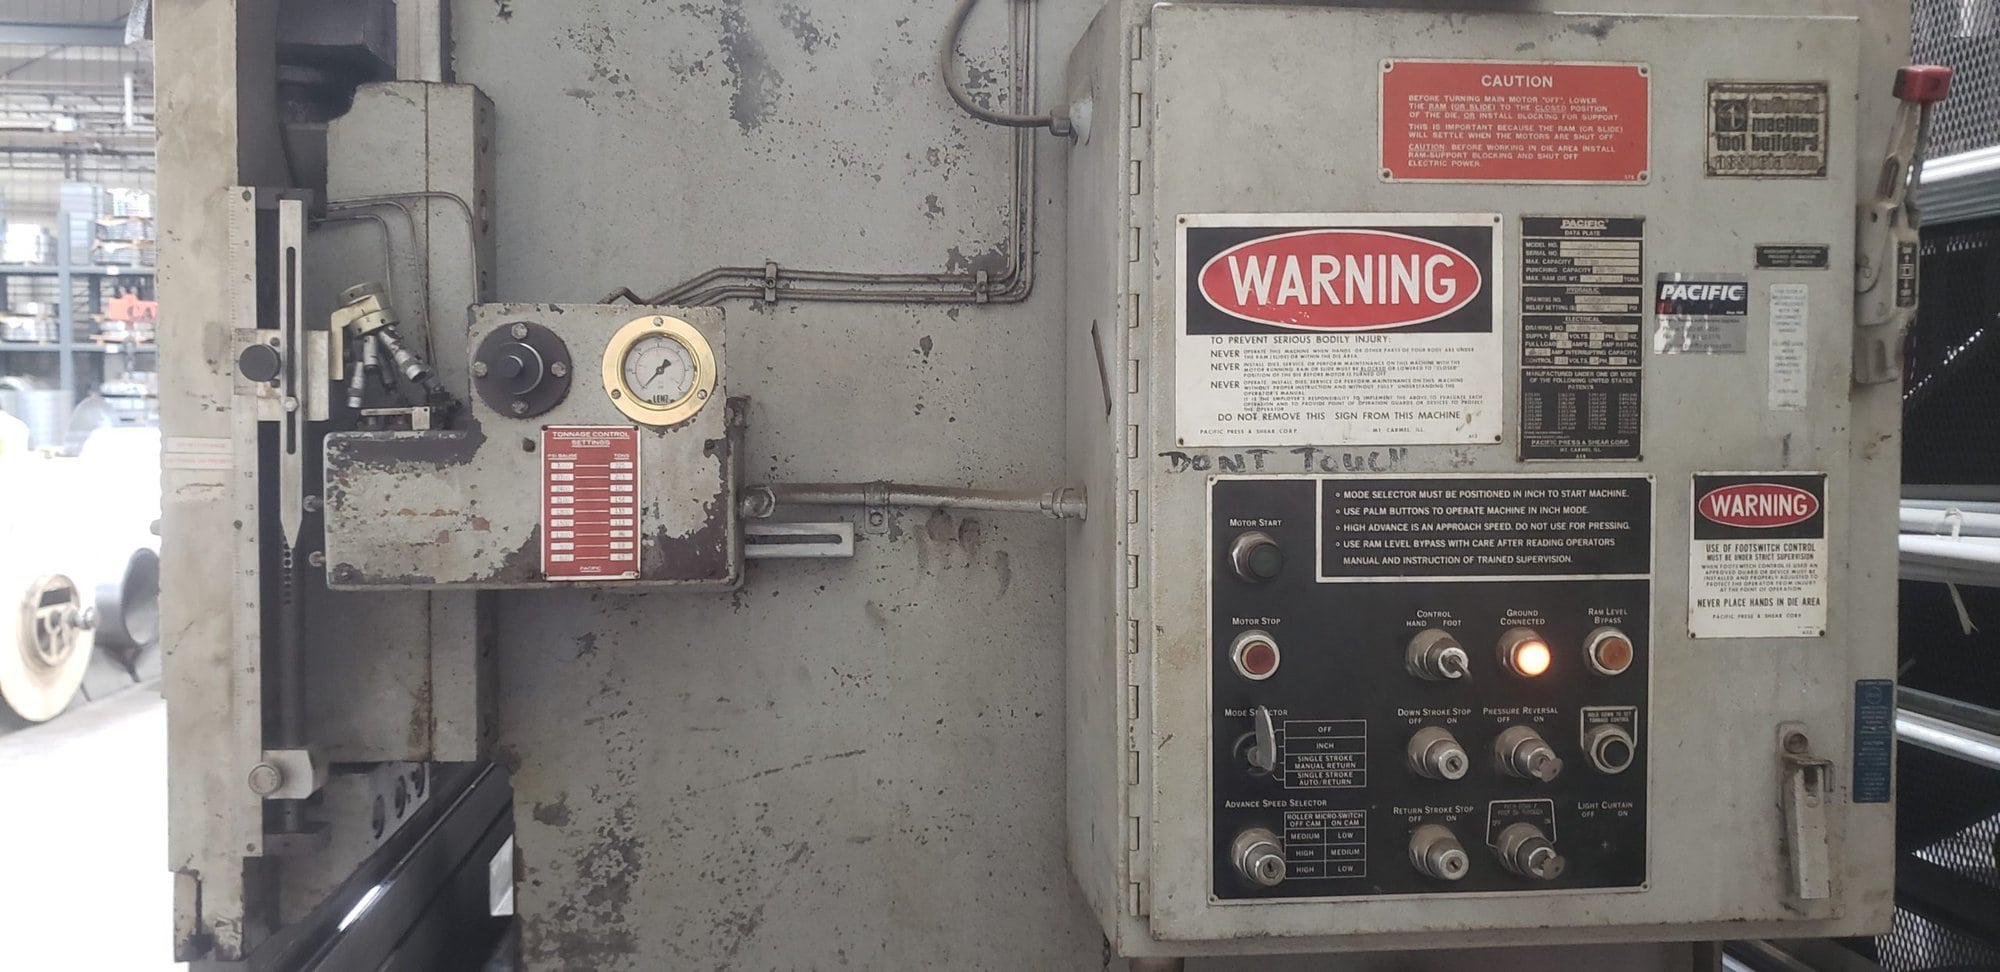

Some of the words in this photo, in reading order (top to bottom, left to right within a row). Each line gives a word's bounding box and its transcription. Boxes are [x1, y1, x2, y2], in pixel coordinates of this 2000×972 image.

[1227, 253, 1457, 306] WARNING
[1660, 284, 1745, 301] PACIFIC
[1211, 336, 1223, 345] TO
[1228, 335, 1267, 344] PREVENT
[1273, 335, 1311, 344] SERIOUS
[1316, 335, 1349, 344] BODILY
[1355, 335, 1392, 344] INJURY:
[1210, 349, 1241, 358] NEVER
[1210, 362, 1241, 371] NEVER
[1210, 380, 1241, 389] NEVER
[1218, 411, 1232, 422] DO
[1237, 411, 1257, 422] NOT
[1262, 411, 1300, 421] REMOVE
[1306, 411, 1325, 421] THIS
[1335, 411, 1357, 421] SIGN
[1362, 411, 1389, 421] FROM
[1394, 411, 1413, 421] THIS
[1418, 410, 1460, 421] MACHINE
[1343, 490, 1369, 499] MODE
[1372, 490, 1416, 499] SELECTOR
[1418, 490, 1442, 499] MUST
[1445, 490, 1456, 499] BE
[1459, 490, 1510, 499] POSITIONED
[1512, 489, 1522, 499] IN
[1524, 489, 1545, 499] INCH
[1548, 489, 1559, 499] TO
[1561, 489, 1586, 499] START
[1589, 489, 1628, 498] MACHINE.
[1710, 494, 1809, 517] WARNING
[1343, 507, 1360, 516] USE
[1363, 506, 1386, 516] PALM
[1389, 506, 1430, 516] BUTTONS
[1432, 506, 1443, 516] TO
[1445, 506, 1484, 515] OPERATE
[1486, 506, 1525, 515] MACHINE
[1528, 506, 1537, 515] IN
[1539, 506, 1560, 515] INCH
[1562, 505, 1588, 515] MODE.
[1343, 523, 1365, 532] HIGH
[1368, 523, 1408, 532] ADVANCE
[1410, 522, 1419, 532] IS
[1421, 522, 1433, 532] AN
[1435, 522, 1481, 532] APPROACH
[1484, 522, 1513, 531] SPEED.
[1515, 522, 1528, 531] DO
[1530, 521, 1547, 531] NOT
[1550, 521, 1566, 531] USE
[1569, 521, 1585, 530] FOR
[1588, 521, 1630, 530] PRESSING.
[1343, 540, 1360, 549] USE
[1363, 539, 1382, 548] RAM
[1384, 539, 1410, 548] LEVEL
[1413, 539, 1446, 548] BYPASS
[1447, 539, 1469, 548] WITH
[1472, 538, 1494, 548] CARE
[1497, 538, 1523, 548] AFTER
[1526, 538, 1563, 547] READING
[1566, 538, 1615, 547] OPERATORS
[1706, 544, 1719, 552] USE
[1723, 544, 1731, 552] OF
[1735, 543, 1780, 552] FOOTSWITCH
[1783, 543, 1815, 552] CONTROL
[1343, 555, 1379, 565] MANUAL
[1381, 555, 1400, 565] AND
[1402, 555, 1460, 565] INSTRUCTION
[1462, 555, 1474, 564] OF
[1477, 554, 1514, 564] TRAINED
[1516, 554, 1573, 564] SUPERVISION.
[1755, 553, 1774, 561] STRICT
[1697, 598, 1720, 607] NEVER
[1723, 598, 1745, 607] PLACE
[1749, 598, 1773, 607] HANDS
[1776, 598, 1784, 607] IN
[1787, 598, 1797, 607] DIE
[1802, 598, 1820, 606] AREA
[1224, 708, 1248, 717] MODE
[1446, 716, 1458, 724] ON
[1316, 742, 1335, 750] INCH
[1225, 799, 1259, 808] ADVANCE
[1262, 799, 1287, 808] SPEED
[1289, 799, 1327, 807] SELECTOR
[1287, 812, 1314, 820] ROLLER
[1315, 812, 1364, 820] MICRO-SWITCH
[1446, 814, 1458, 822] ON
[1290, 832, 1321, 840] MEDIUM
[1330, 848, 1361, 856] MEDIUM
